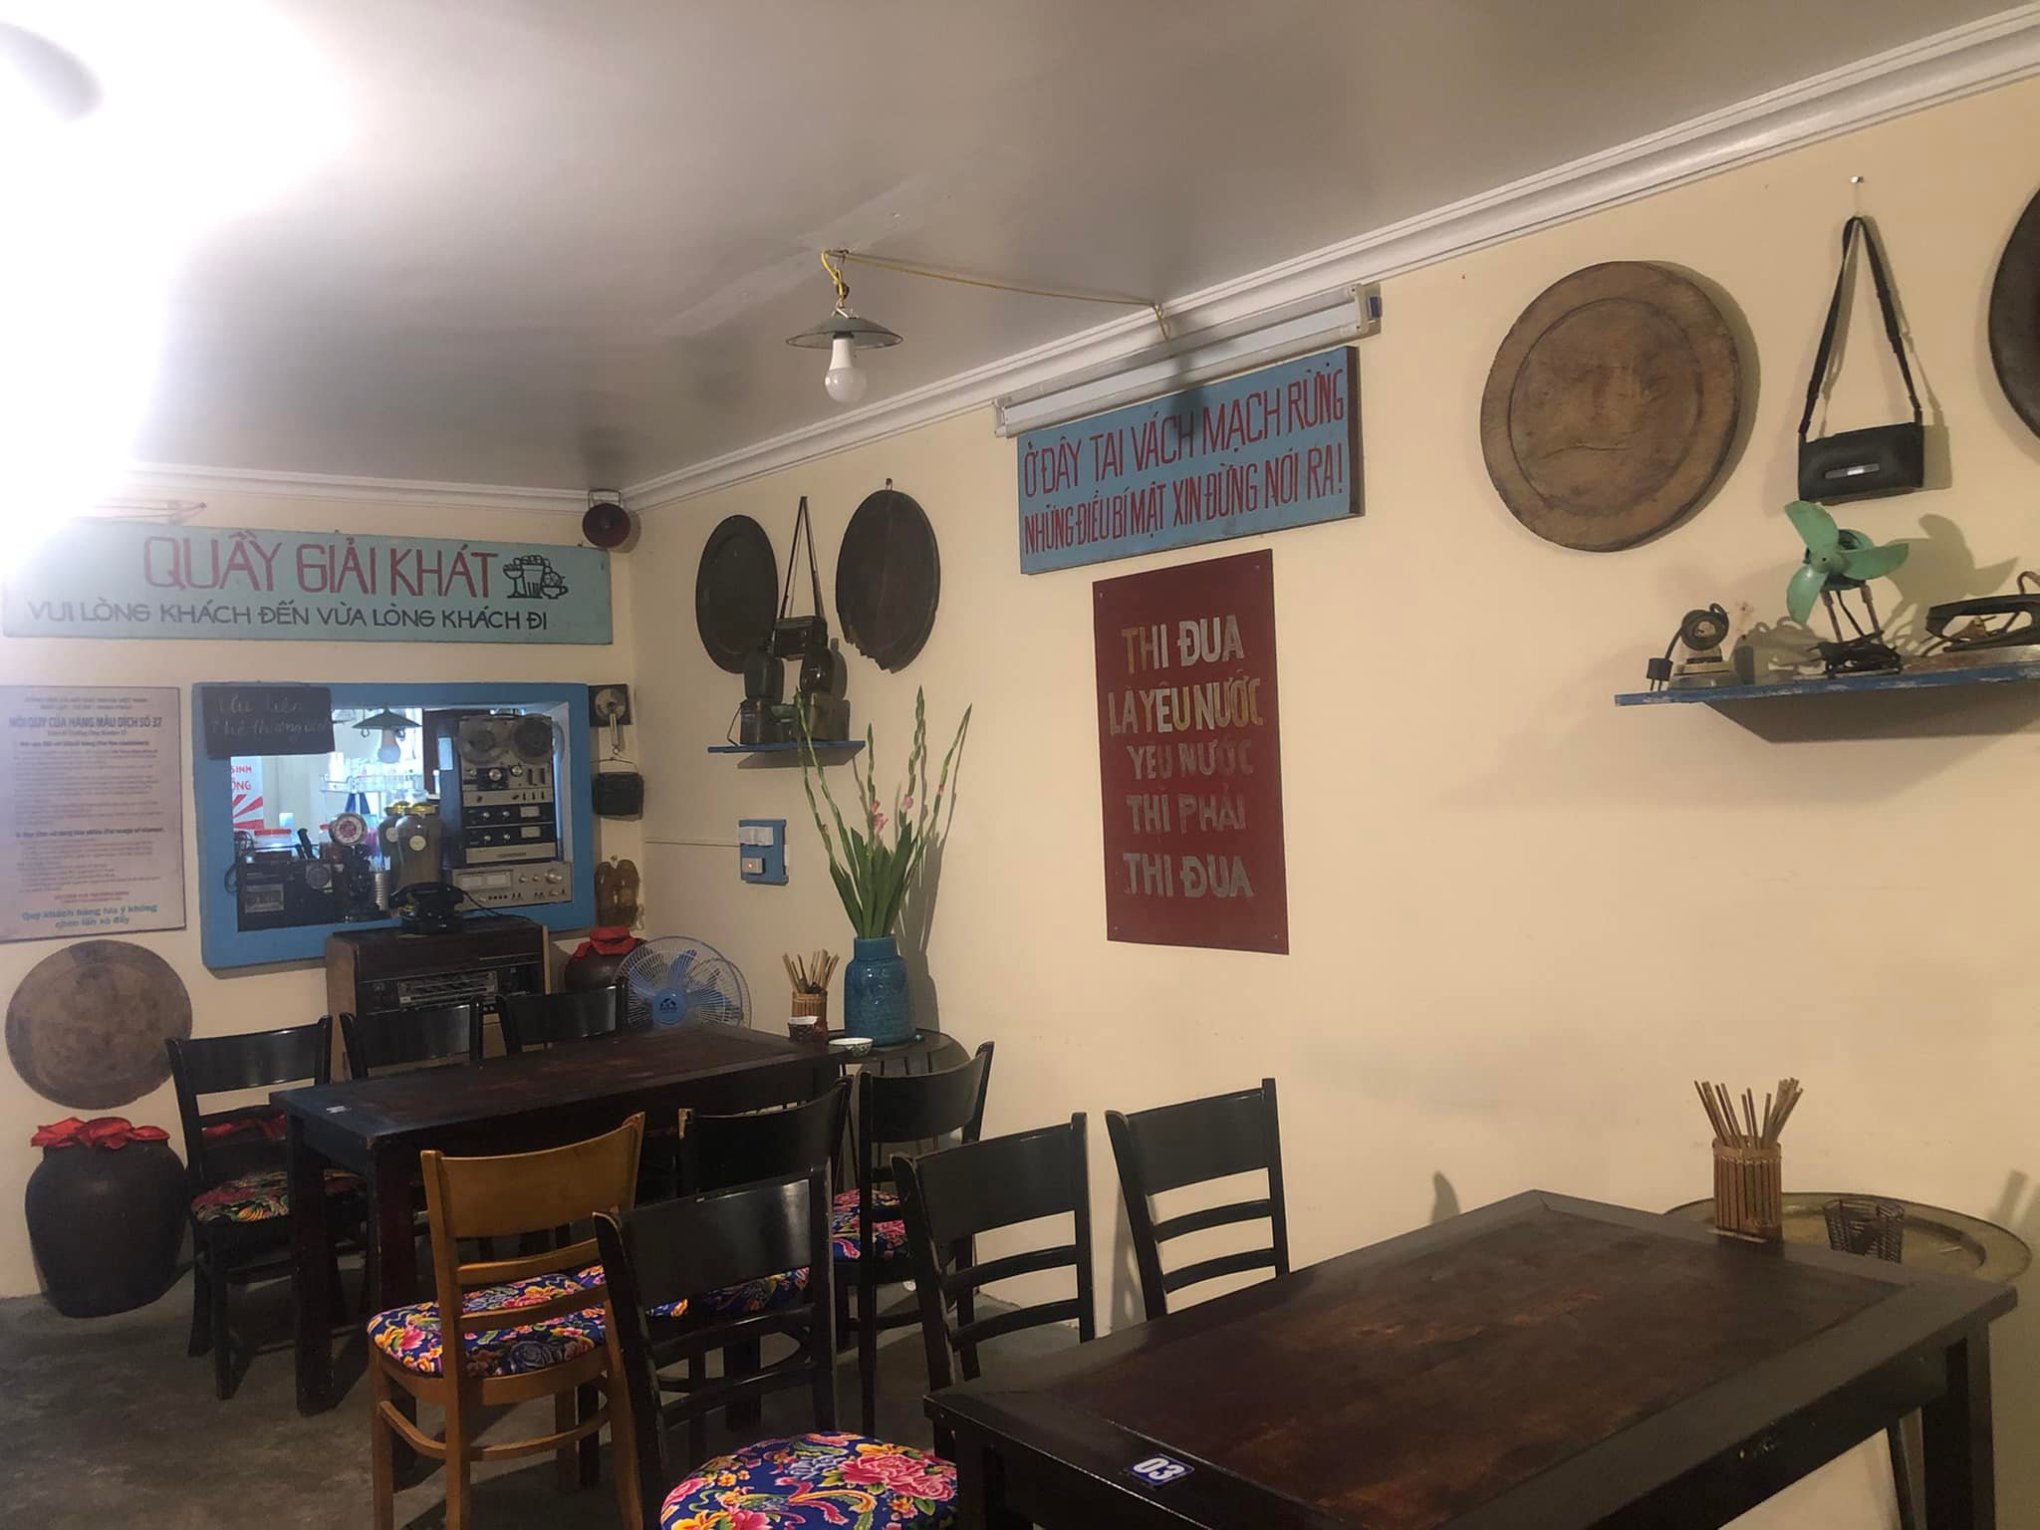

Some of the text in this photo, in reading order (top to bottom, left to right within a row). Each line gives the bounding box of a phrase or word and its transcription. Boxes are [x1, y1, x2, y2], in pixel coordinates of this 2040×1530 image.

[1024, 368, 1344, 498] Ở ĐÂY TAI VÁCH MẠCH RỪNG
[1112, 486, 1130, 540] BÍ
[1172, 475, 1202, 527] XIN
[1204, 463, 1258, 521] ĐỪNG
[1264, 448, 1299, 509] NÓI
[1307, 442, 1343, 500] RA!
[143, 530, 499, 599] QUẦY GIẢI KHÁT
[27, 596, 548, 631] VUI LÒNG KHÁCH ĐẾN VỪA LÒNG KHÁCH ĐI
[1121, 614, 1246, 675] THI ĐUA
[1107, 669, 1263, 736] LÀ YÊU NƯỚC
[1178, 735, 1254, 778] NƯỚC
[1177, 782, 1247, 835] PHẢI
[1122, 852, 1255, 899] THI ĐUA
[1132, 1457, 1186, 1481] 03
